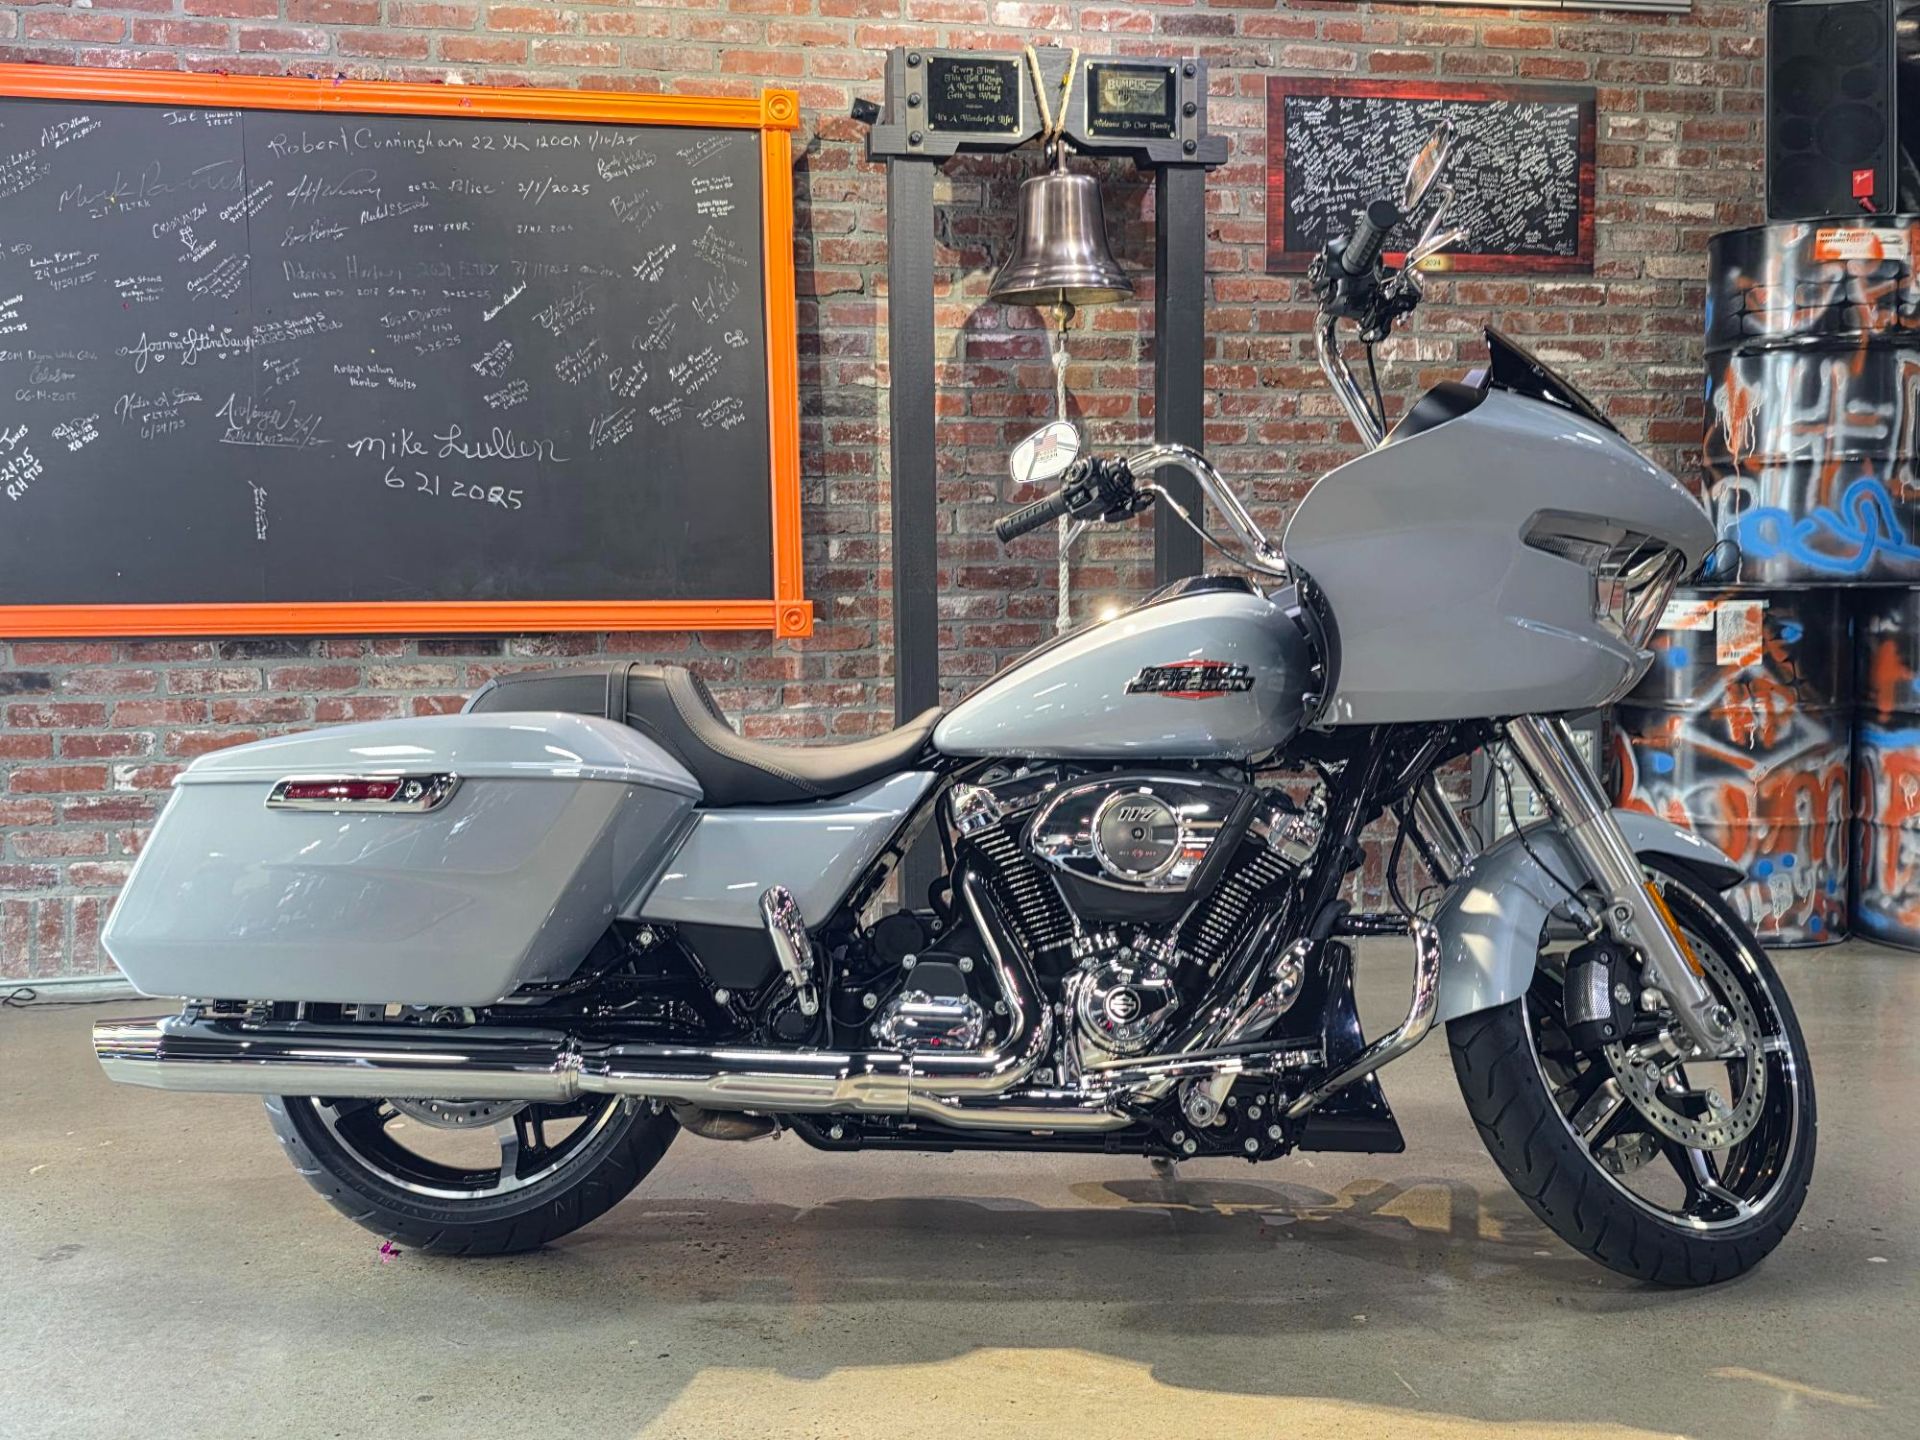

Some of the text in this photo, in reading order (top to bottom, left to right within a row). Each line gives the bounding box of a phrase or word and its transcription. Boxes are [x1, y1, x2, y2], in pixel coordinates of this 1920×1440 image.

[957, 83, 974, 92] New
[1106, 79, 1147, 91] BUMPUS
[960, 114, 995, 125] Wonderful
[1094, 119, 1120, 128] Welcome
[384, 466, 406, 489] 6
